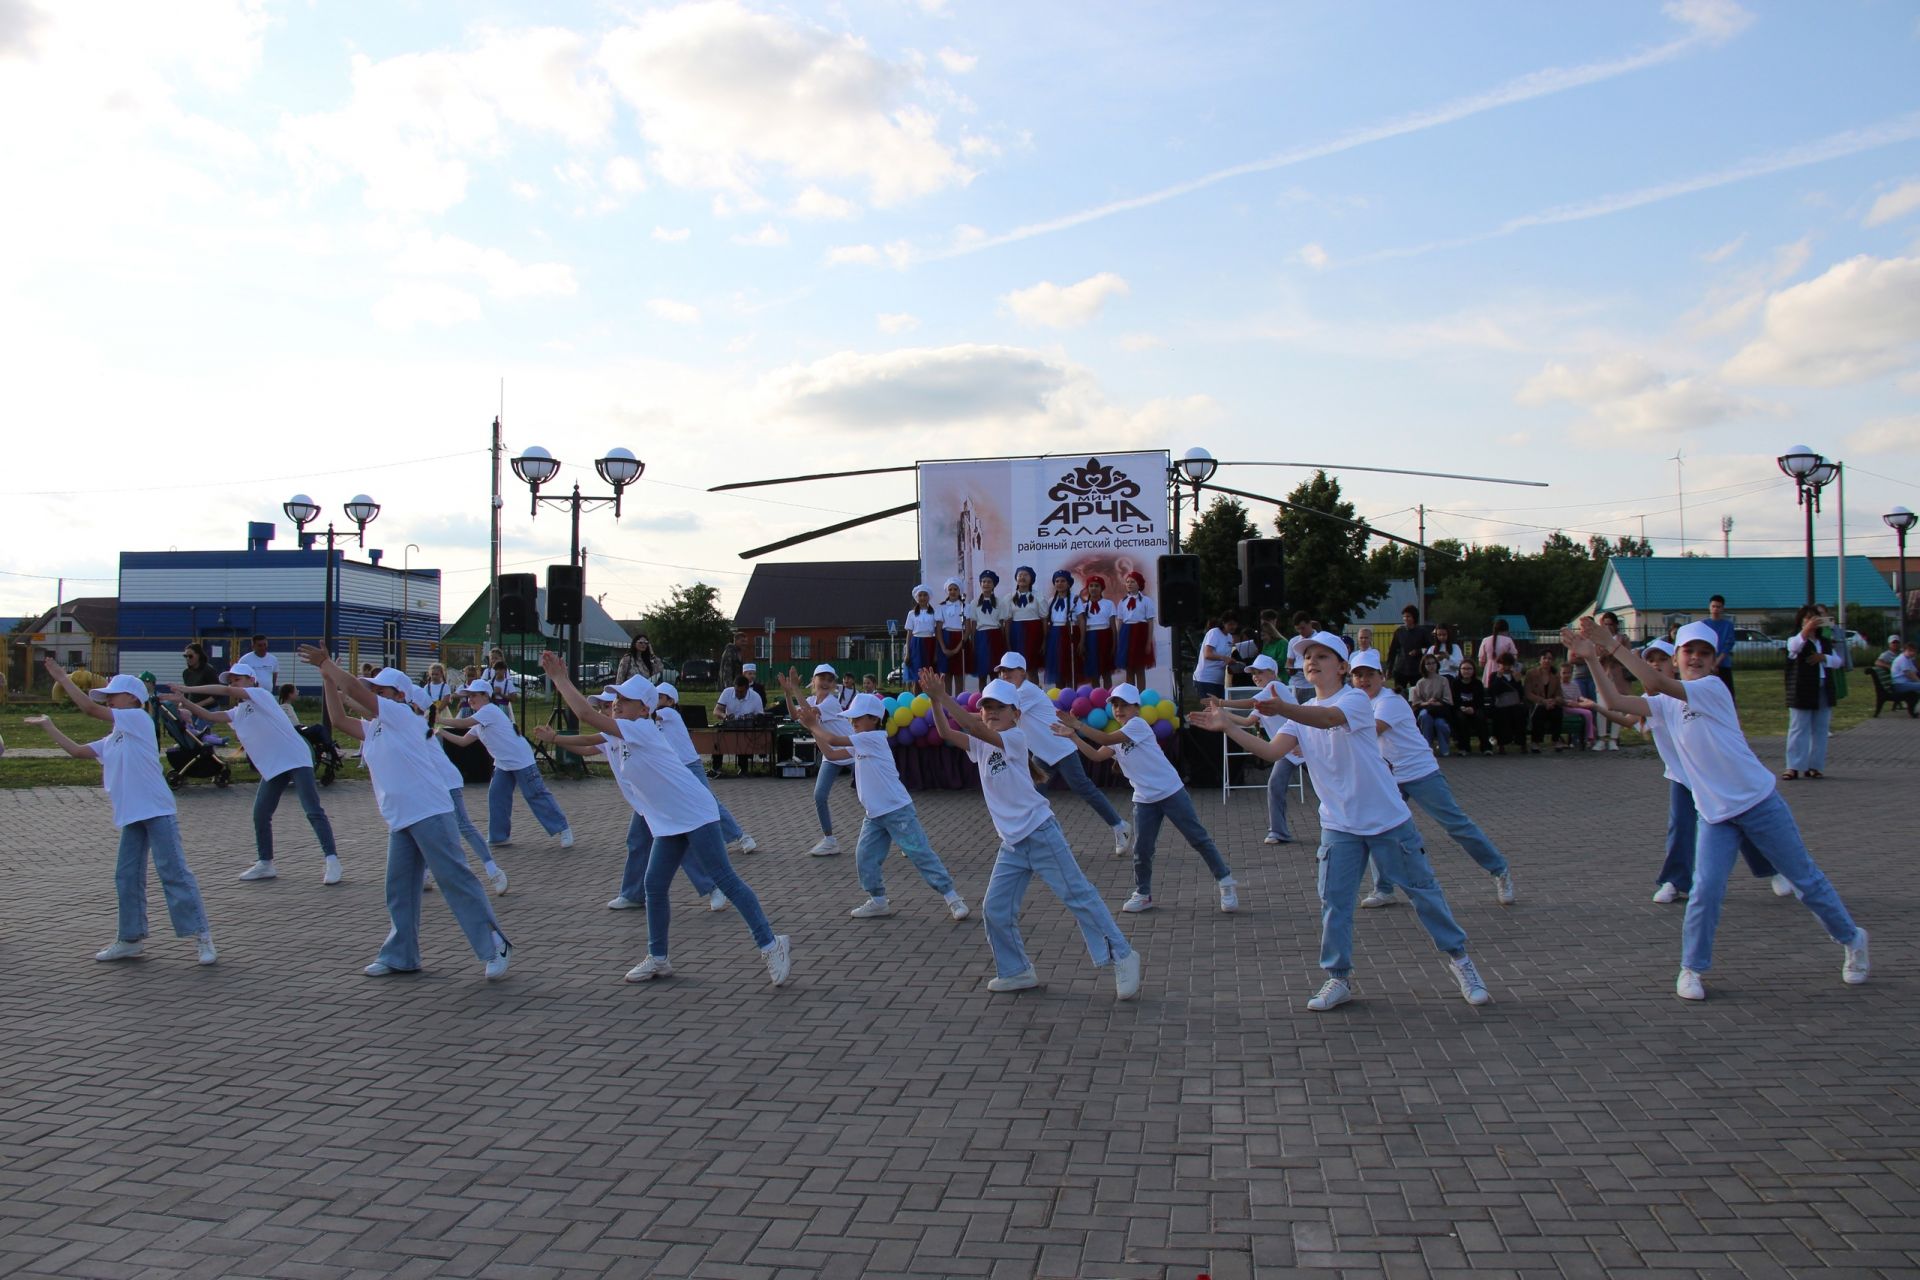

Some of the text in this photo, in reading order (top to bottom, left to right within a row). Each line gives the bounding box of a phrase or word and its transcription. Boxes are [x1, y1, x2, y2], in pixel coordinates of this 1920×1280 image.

[1039, 500, 1152, 526] АРЧА
[1038, 524, 1153, 538] БАЛАСЫ
[1017, 537, 1168, 553] районный детский фестиваль
